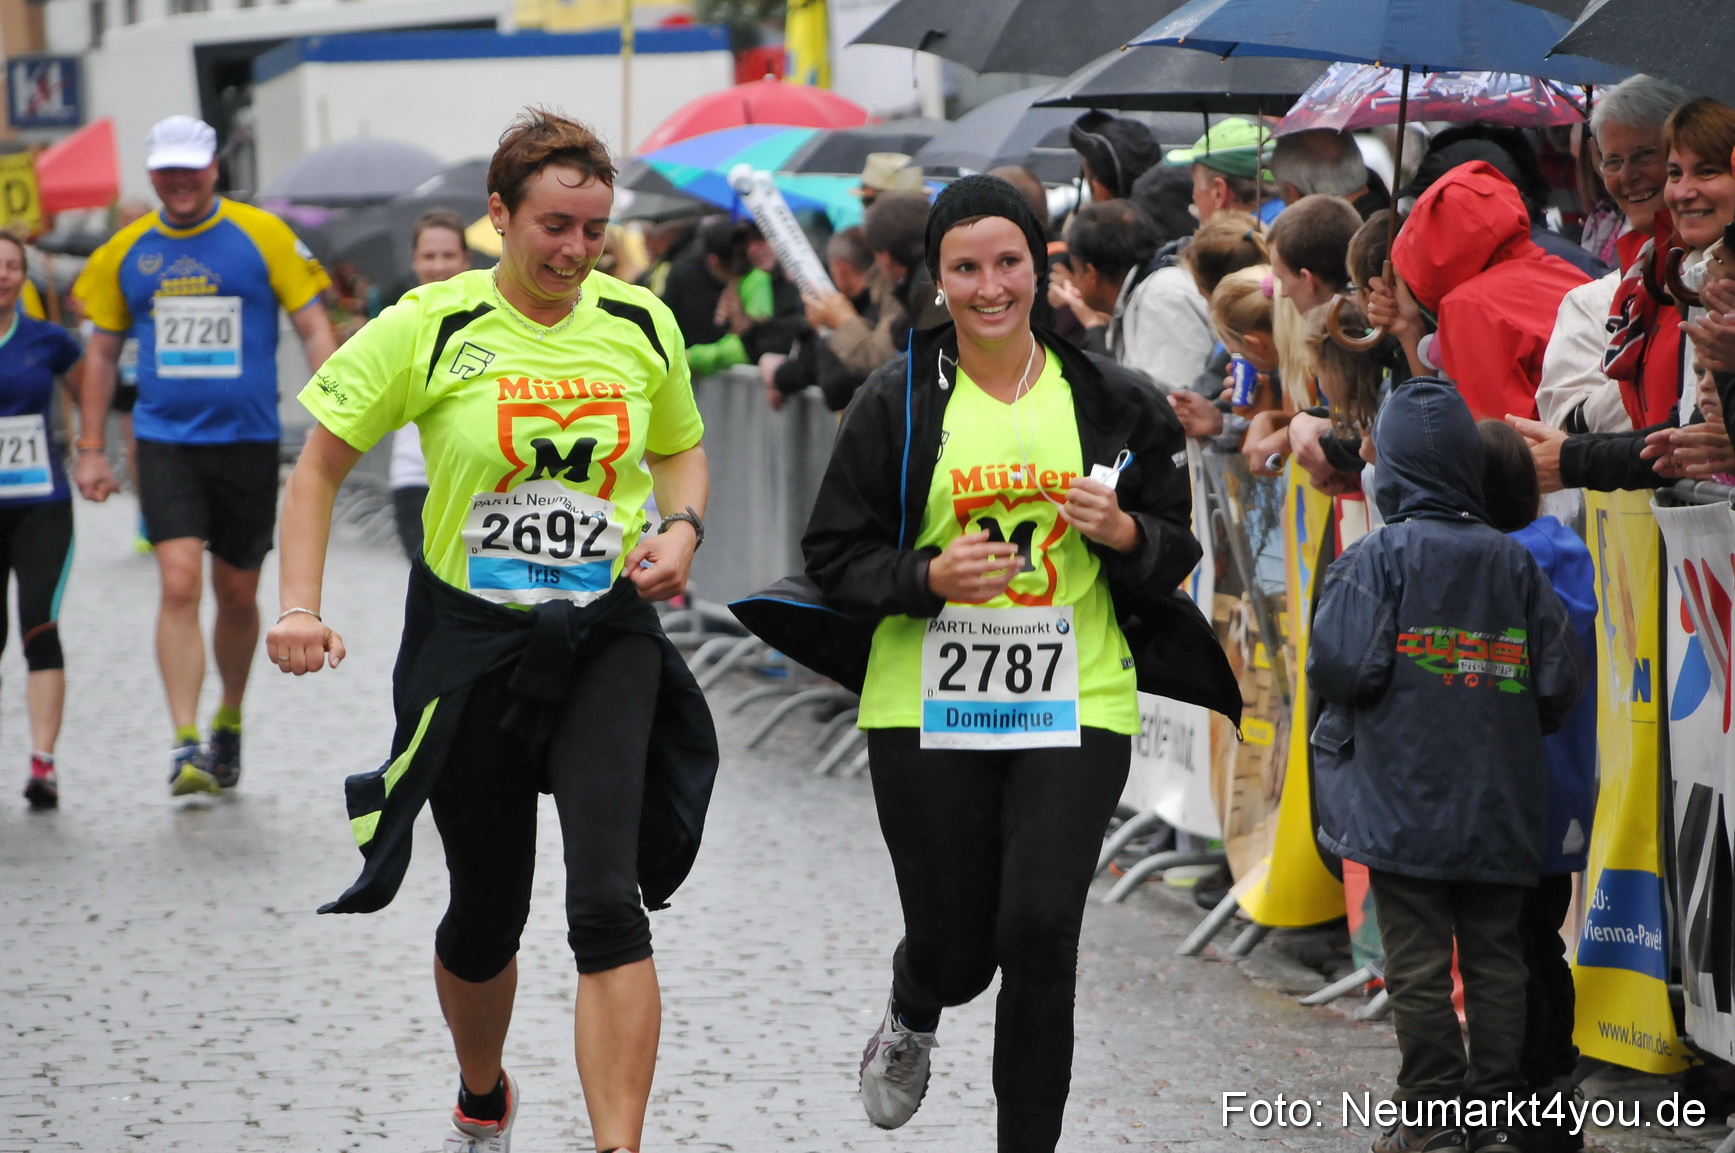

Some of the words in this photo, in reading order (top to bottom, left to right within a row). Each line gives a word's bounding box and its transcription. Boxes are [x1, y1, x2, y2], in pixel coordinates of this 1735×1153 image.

[164, 316, 232, 345] 2720
[496, 376, 627, 400] Müller
[949, 463, 1077, 495] Müller
[481, 509, 608, 560] 2692
[528, 564, 560, 584] Iris
[928, 620, 978, 634] PARTL
[982, 622, 1050, 636] Neumarkt
[938, 641, 1063, 694] 2787
[946, 707, 1053, 732] Dominique
[1597, 1020, 1673, 1057] www.kann.de
